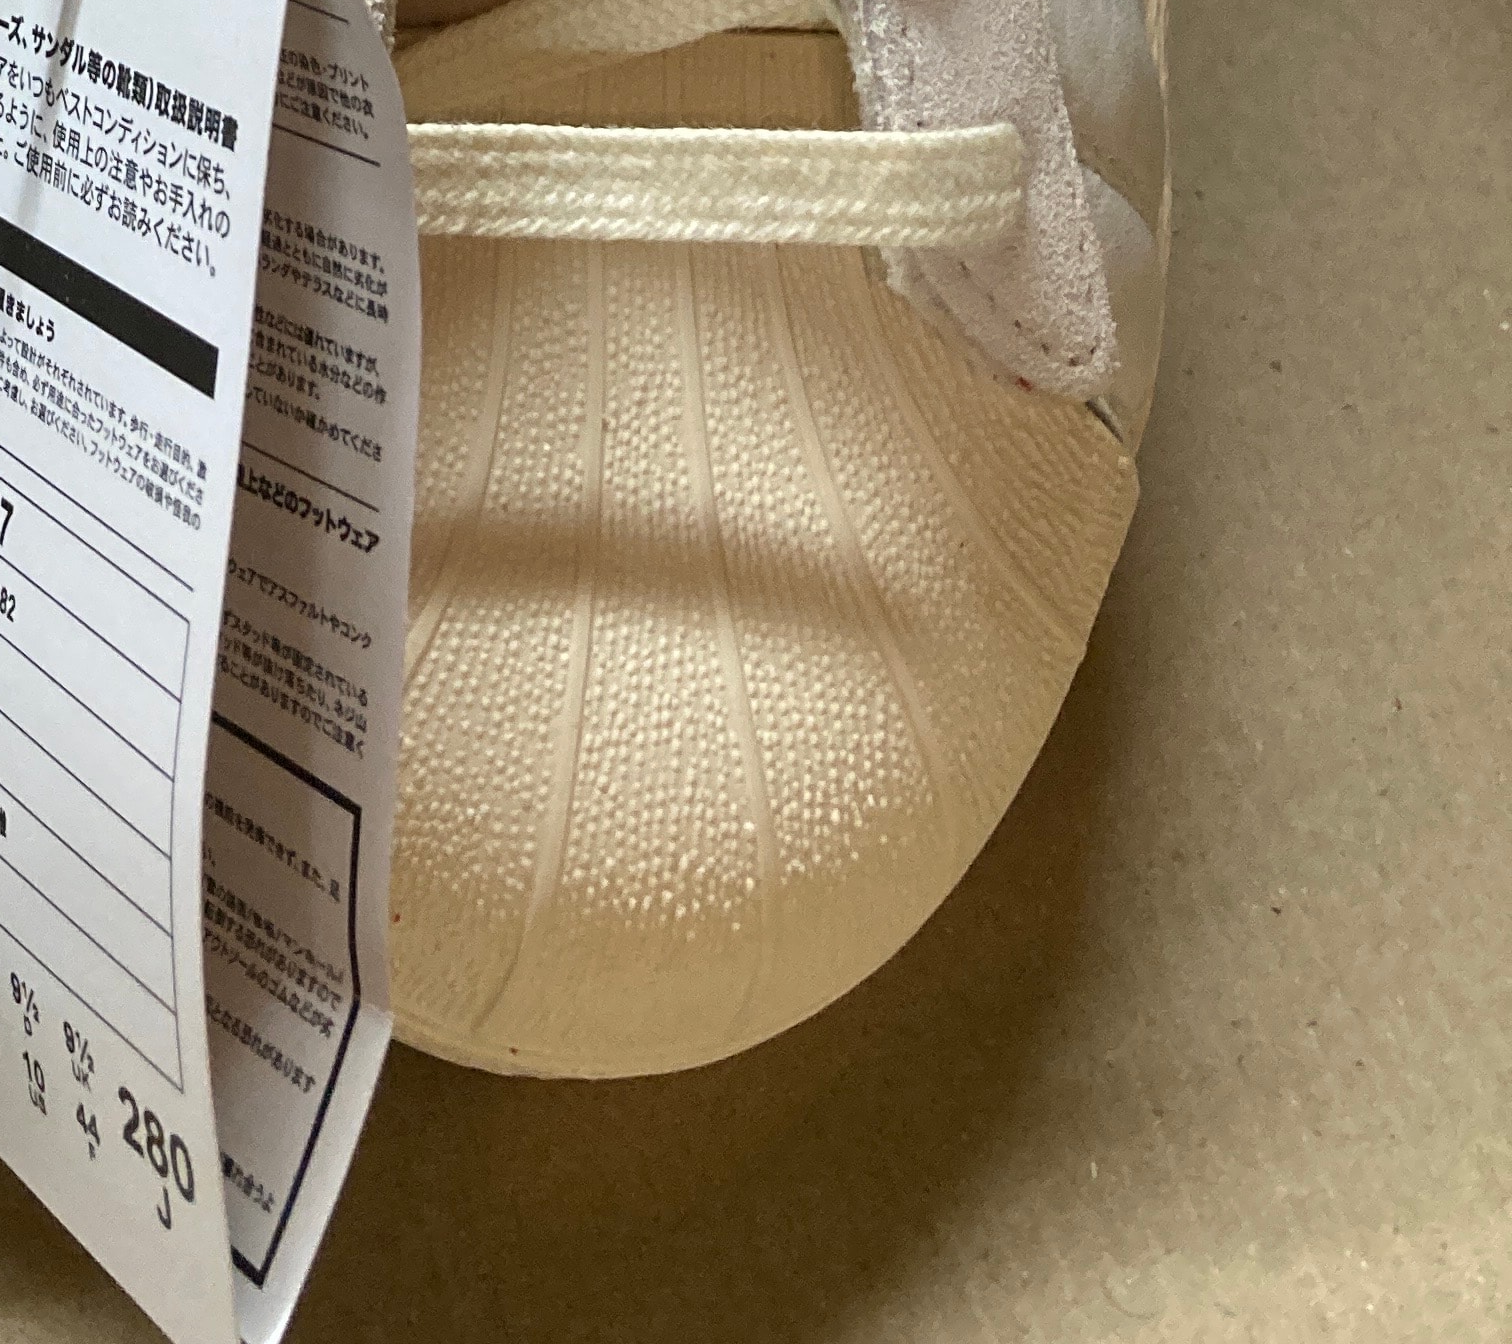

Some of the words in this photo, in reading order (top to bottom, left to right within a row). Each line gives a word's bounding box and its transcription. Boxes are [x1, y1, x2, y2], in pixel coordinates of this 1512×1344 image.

[22, 1051, 45, 1093] 10
[76, 1102, 101, 1147] 44
[118, 1086, 196, 1204] 280
[157, 1185, 172, 1230] J
